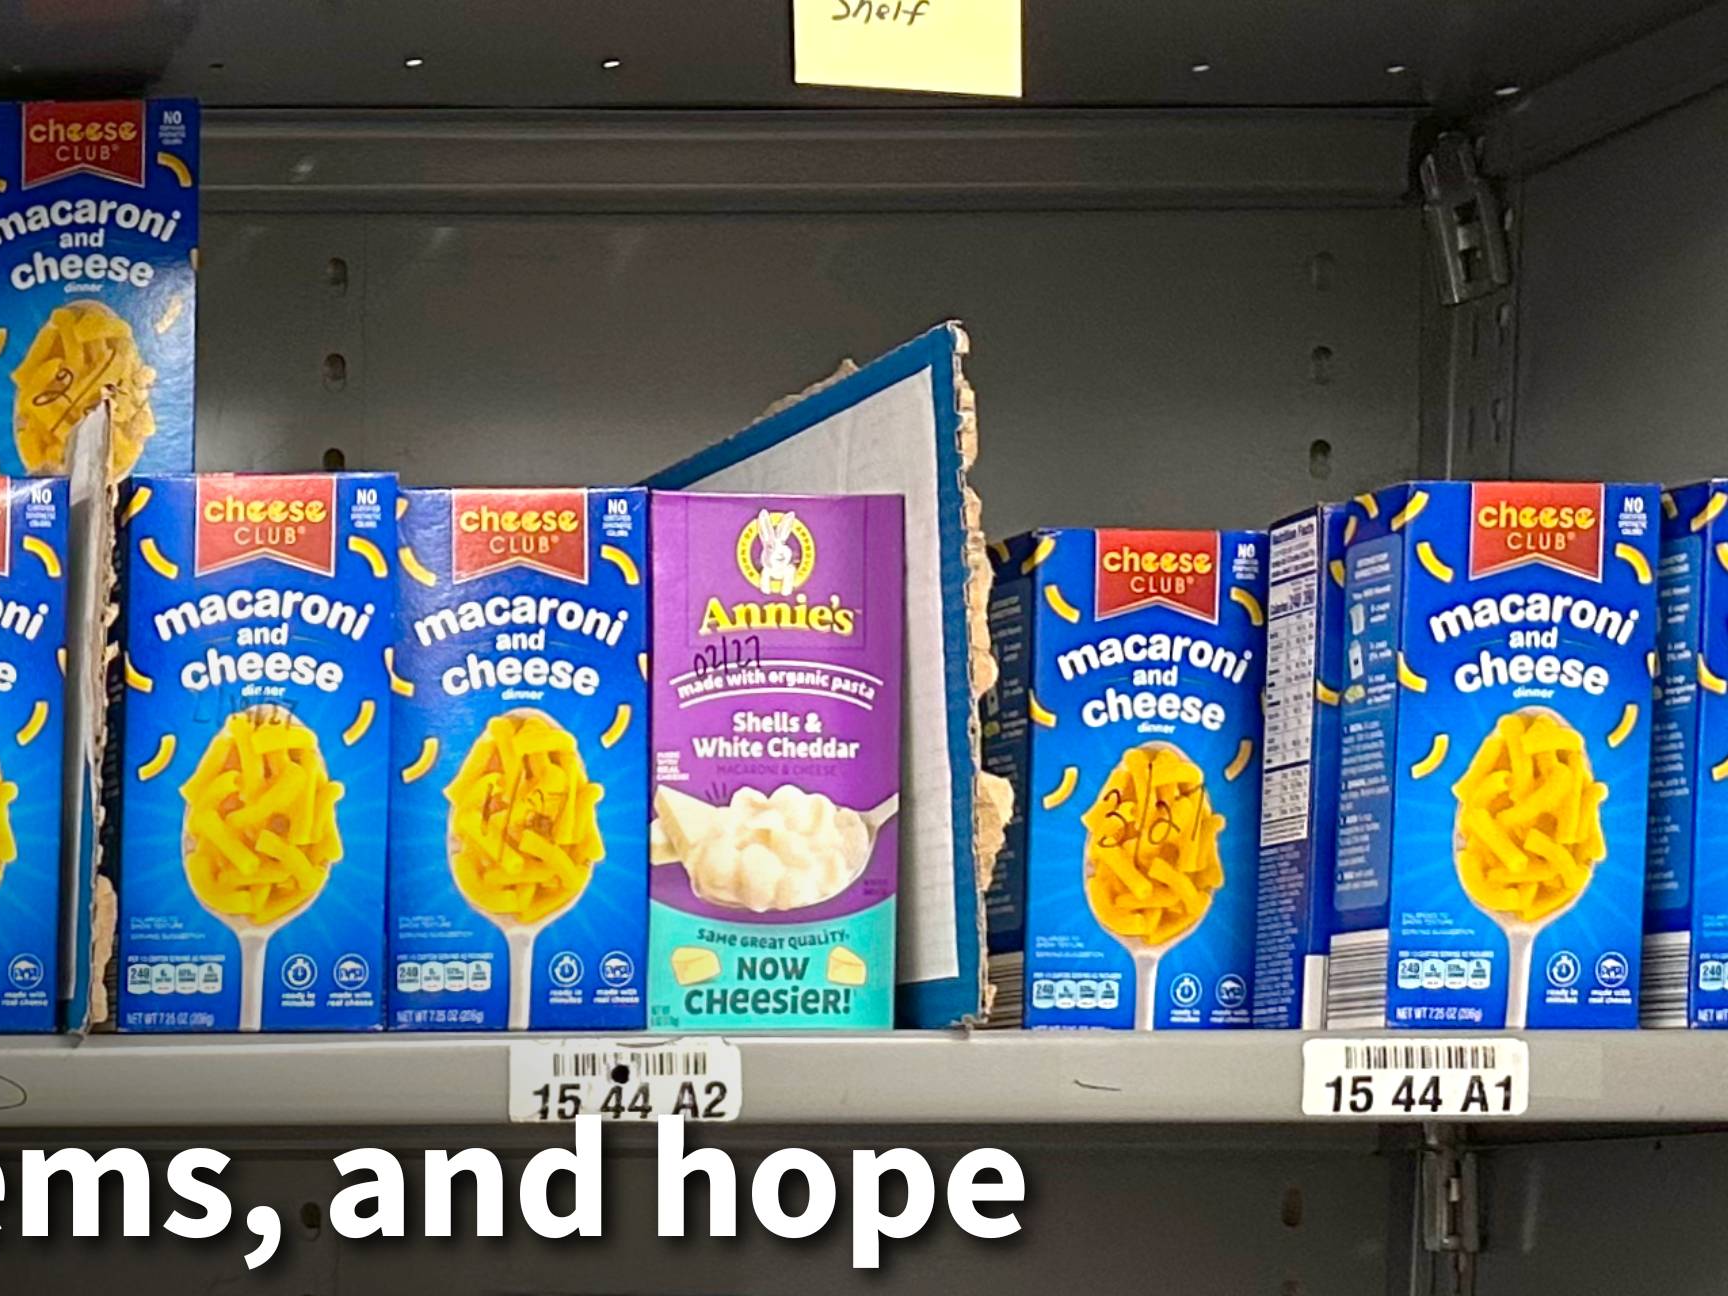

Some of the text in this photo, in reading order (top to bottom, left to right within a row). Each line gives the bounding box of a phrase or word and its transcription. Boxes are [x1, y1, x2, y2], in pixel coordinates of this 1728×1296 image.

[10, 252, 155, 290] cheese
[698, 593, 855, 636] Annie's
[677, 669, 875, 700] made with organic pasta
[733, 712, 822, 733] Shells &
[692, 737, 860, 758] White Cheddar
[737, 957, 810, 980] NOW
[531, 1081, 729, 1121] 15 44 A2
[1324, 1074, 1513, 1113] 15 44 A1
